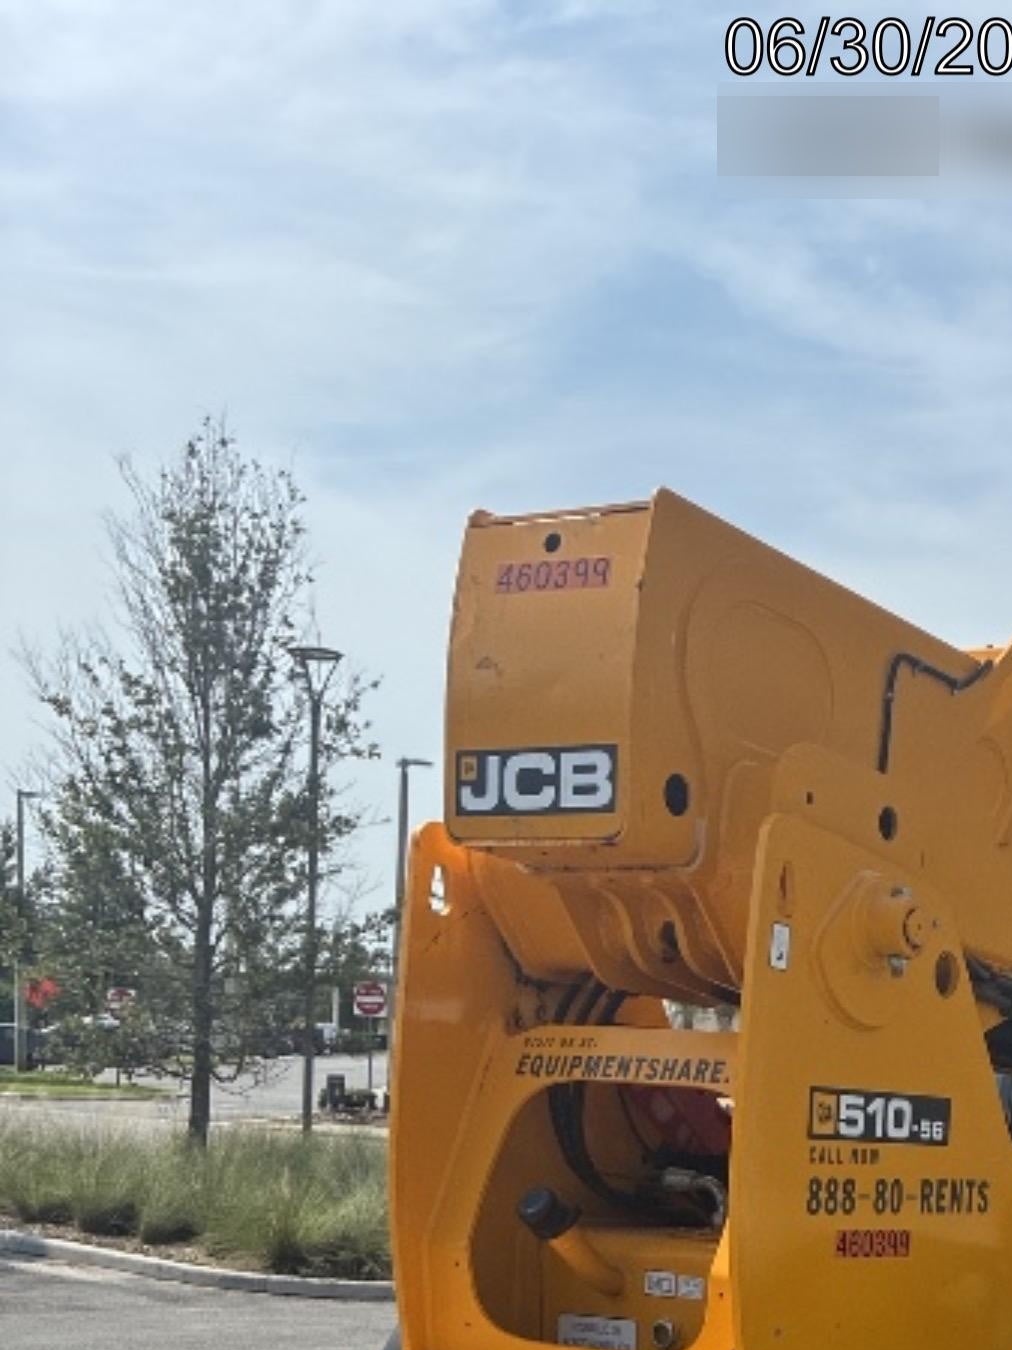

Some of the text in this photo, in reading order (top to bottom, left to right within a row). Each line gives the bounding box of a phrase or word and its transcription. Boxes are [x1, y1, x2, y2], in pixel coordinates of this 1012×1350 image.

[496, 556, 612, 592] 460399
[459, 750, 613, 811] JCB
[806, 1177, 991, 1215] 888-80-RENTS
